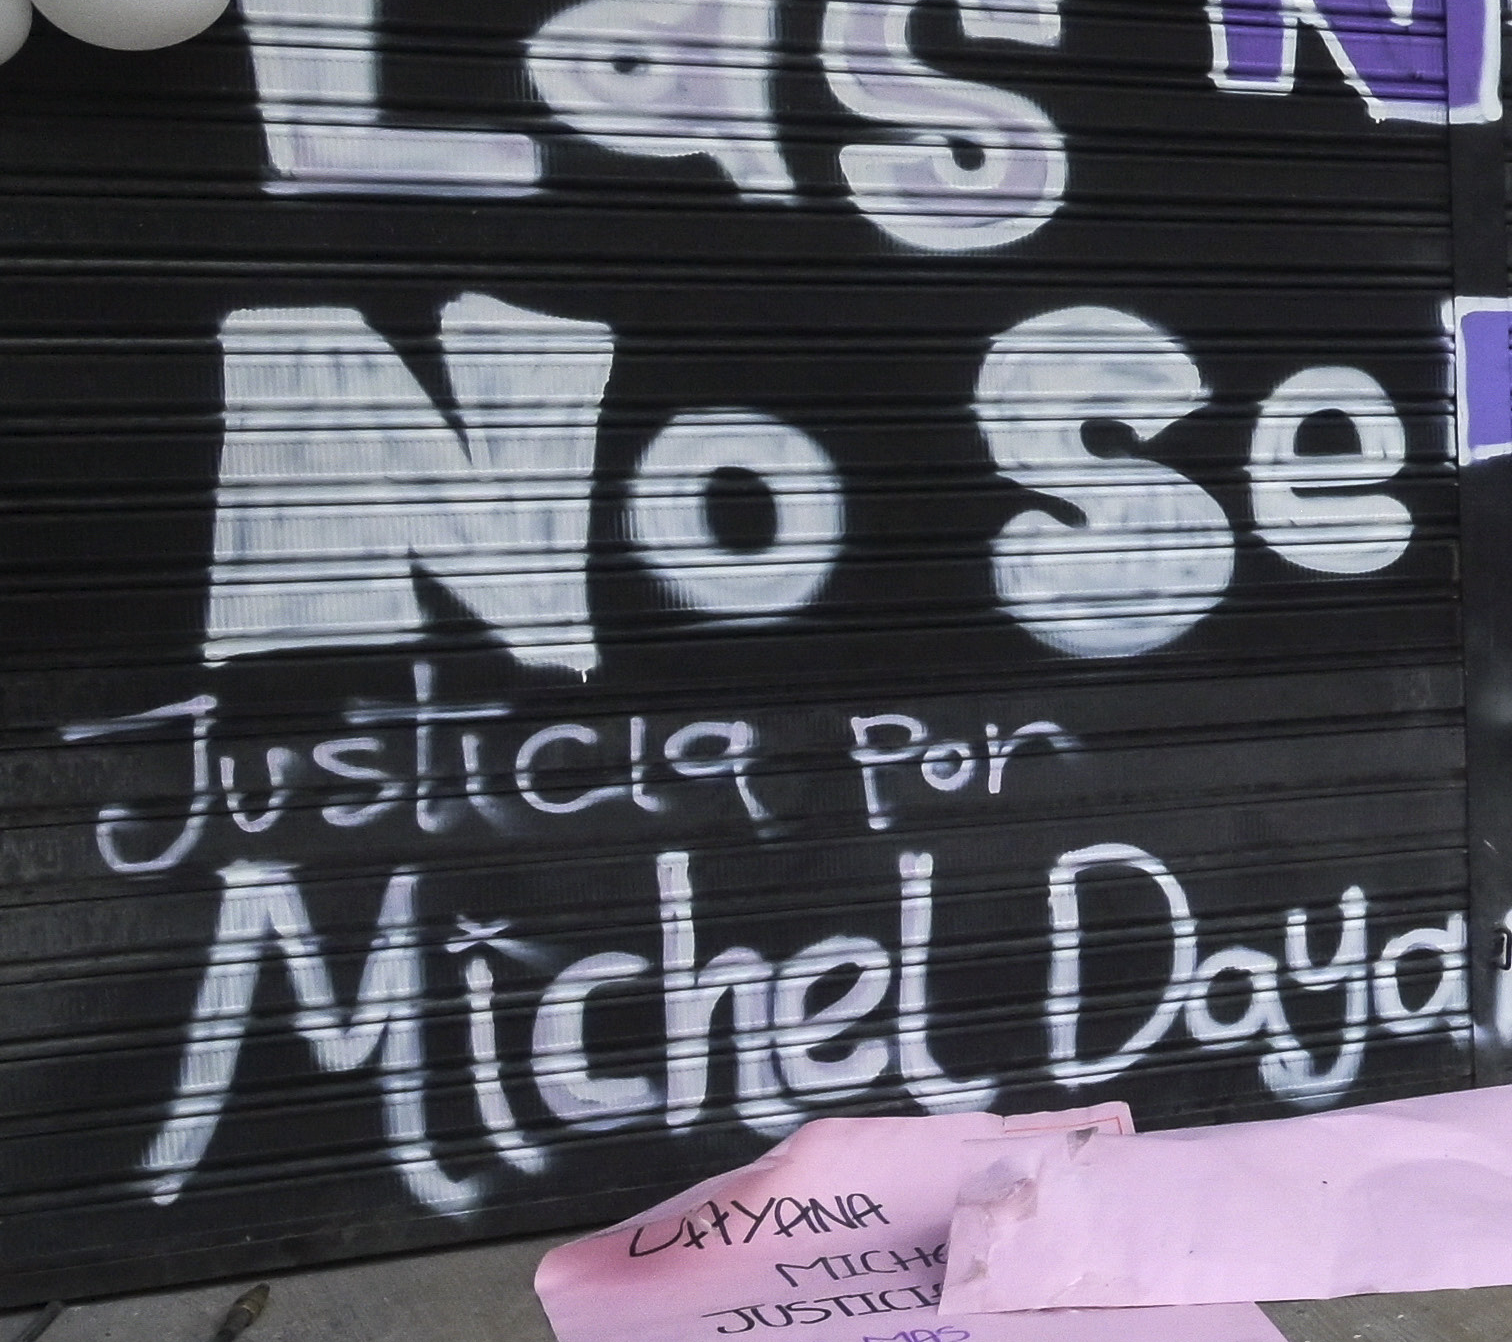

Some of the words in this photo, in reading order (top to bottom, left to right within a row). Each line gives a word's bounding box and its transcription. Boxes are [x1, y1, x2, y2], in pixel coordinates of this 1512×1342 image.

[203, 292, 850, 681] No
[971, 305, 1414, 659] Se
[61, 663, 785, 874] Justicia
[848, 713, 1085, 831] Por
[138, 850, 1001, 1215] Michel
